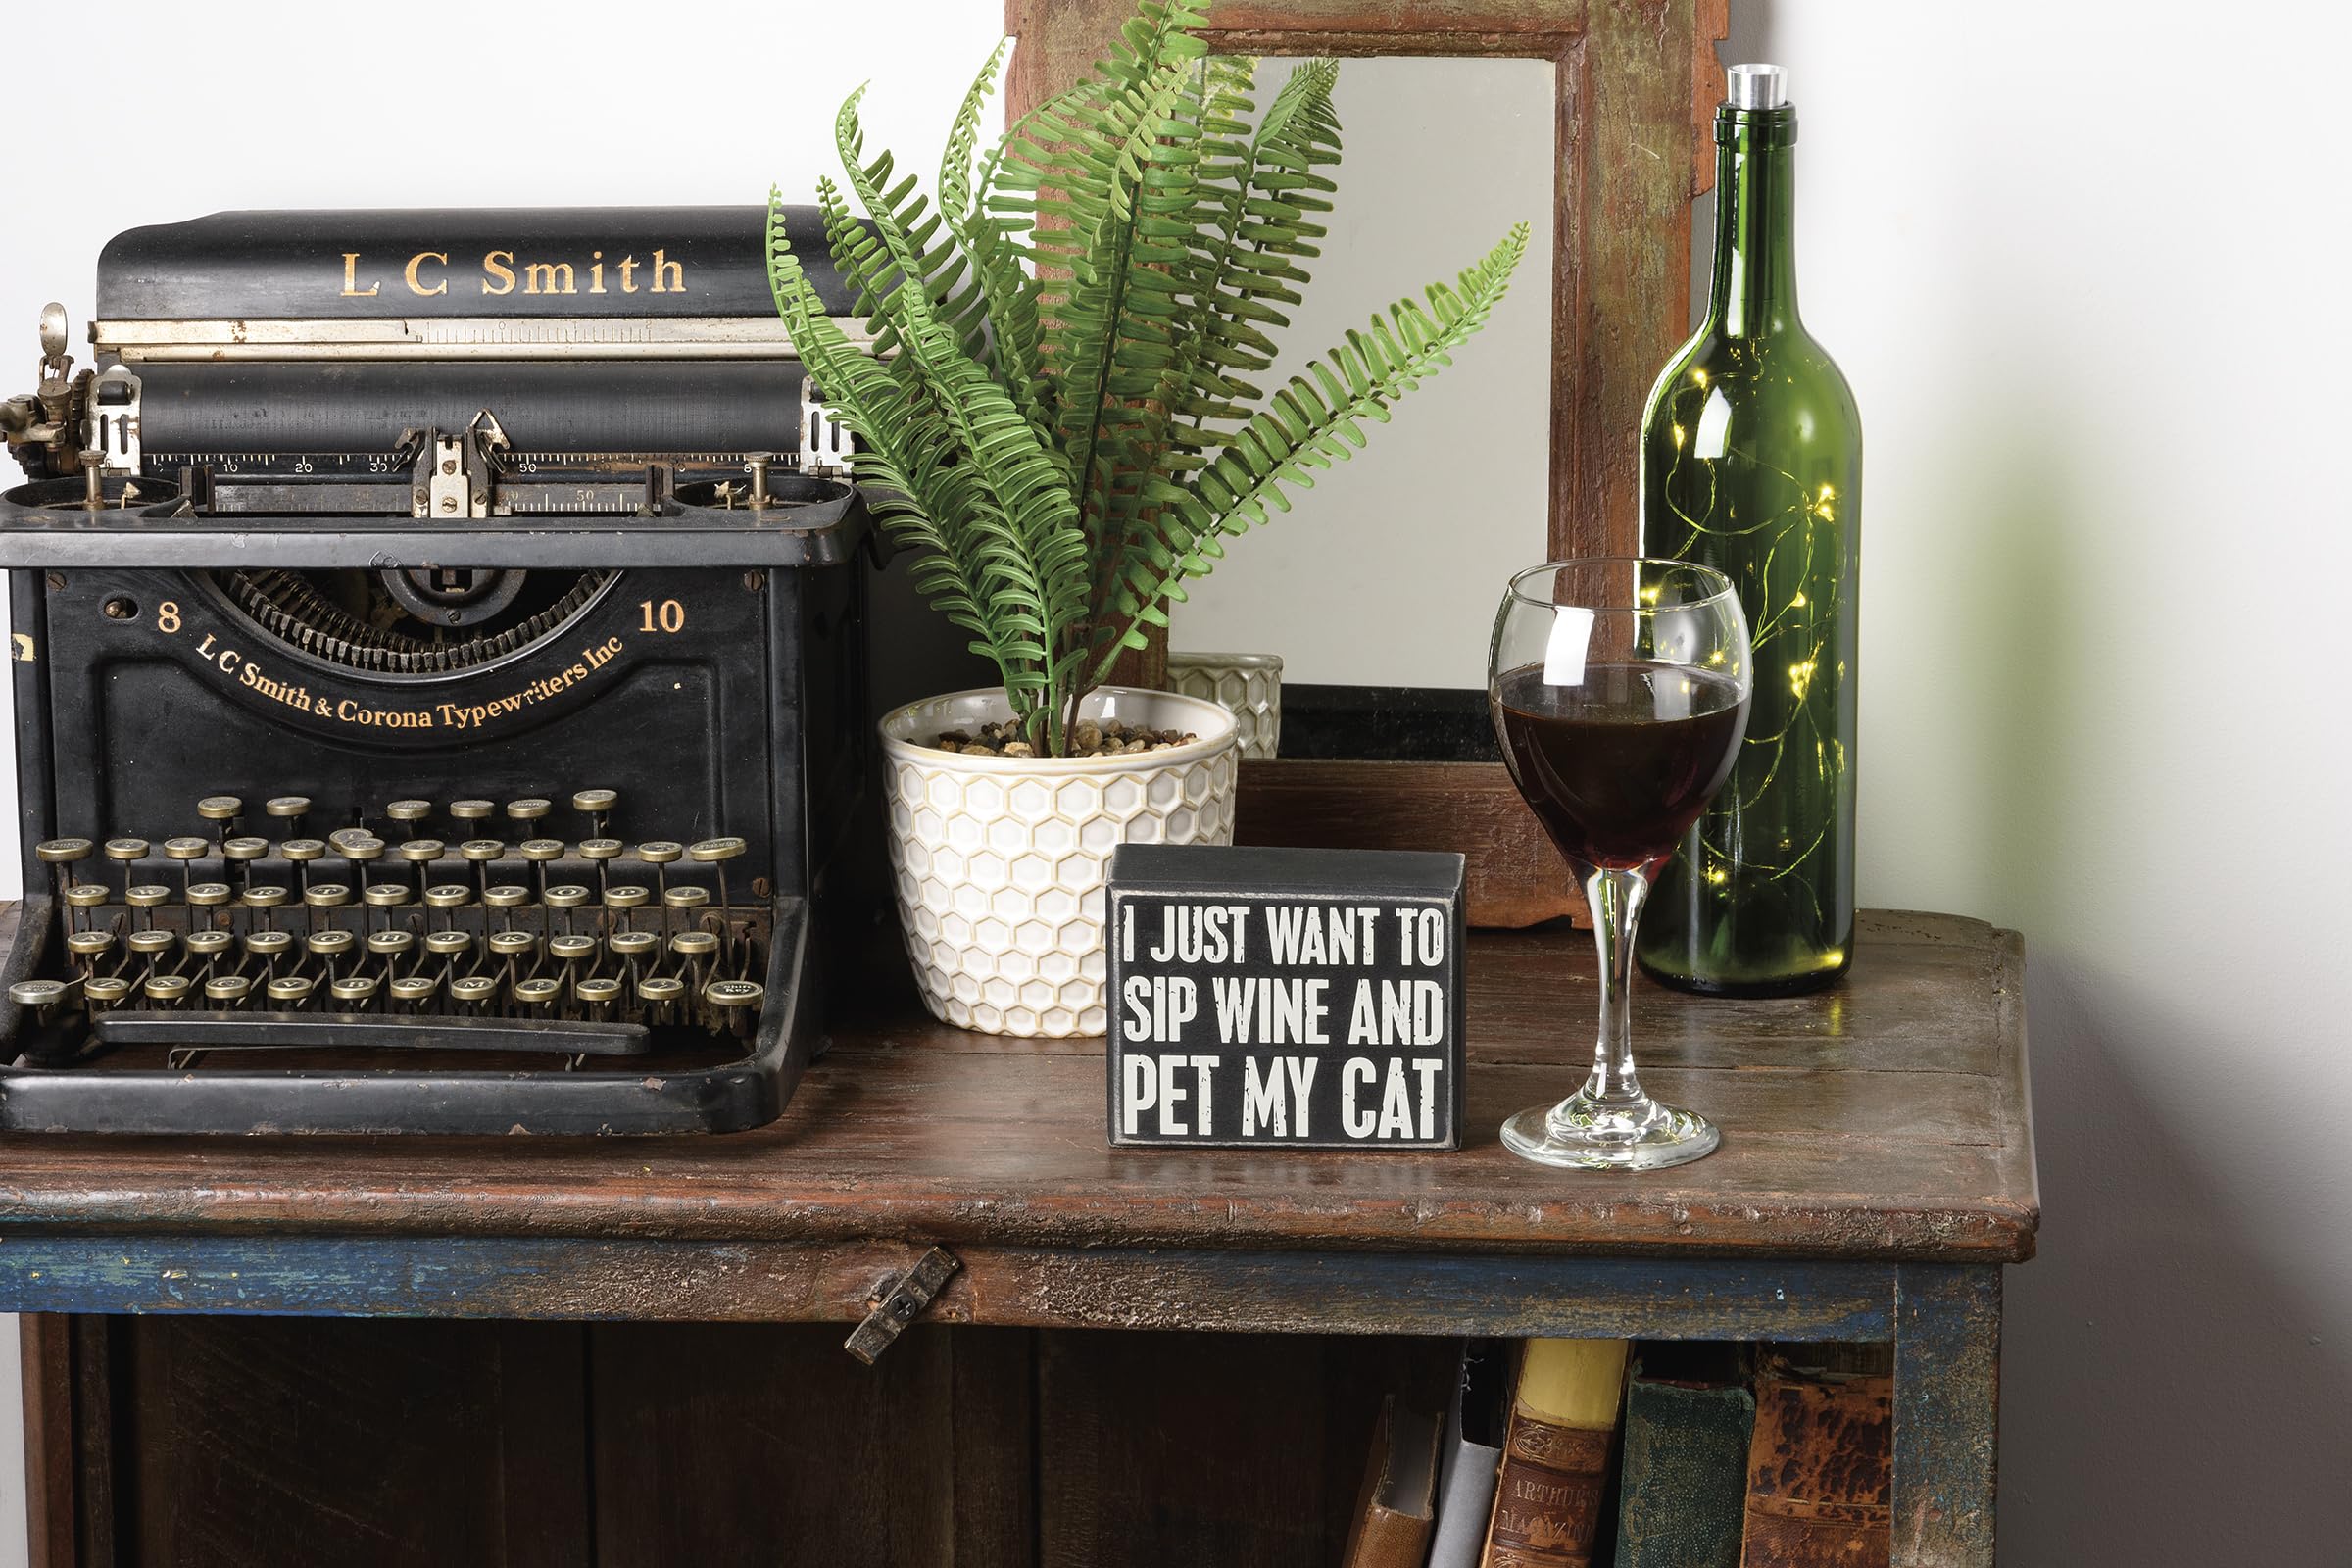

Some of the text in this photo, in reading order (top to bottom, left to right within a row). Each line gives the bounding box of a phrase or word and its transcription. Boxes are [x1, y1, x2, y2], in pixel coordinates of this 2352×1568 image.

[340, 248, 688, 298] L C Smith
[223, 463, 238, 473] 10
[295, 463, 313, 473] 20
[369, 463, 388, 473] 30
[518, 463, 537, 473] 50
[576, 489, 595, 501] 50
[157, 601, 182, 634] 8
[639, 600, 685, 633] 10
[196, 633, 623, 729] L C Smith & Corona Typewriters Inc
[1123, 904, 1445, 967] I JUST WANT TO
[1123, 975, 1444, 1047] SIP WINE AND
[1123, 1054, 1443, 1140] PET MY CAT
